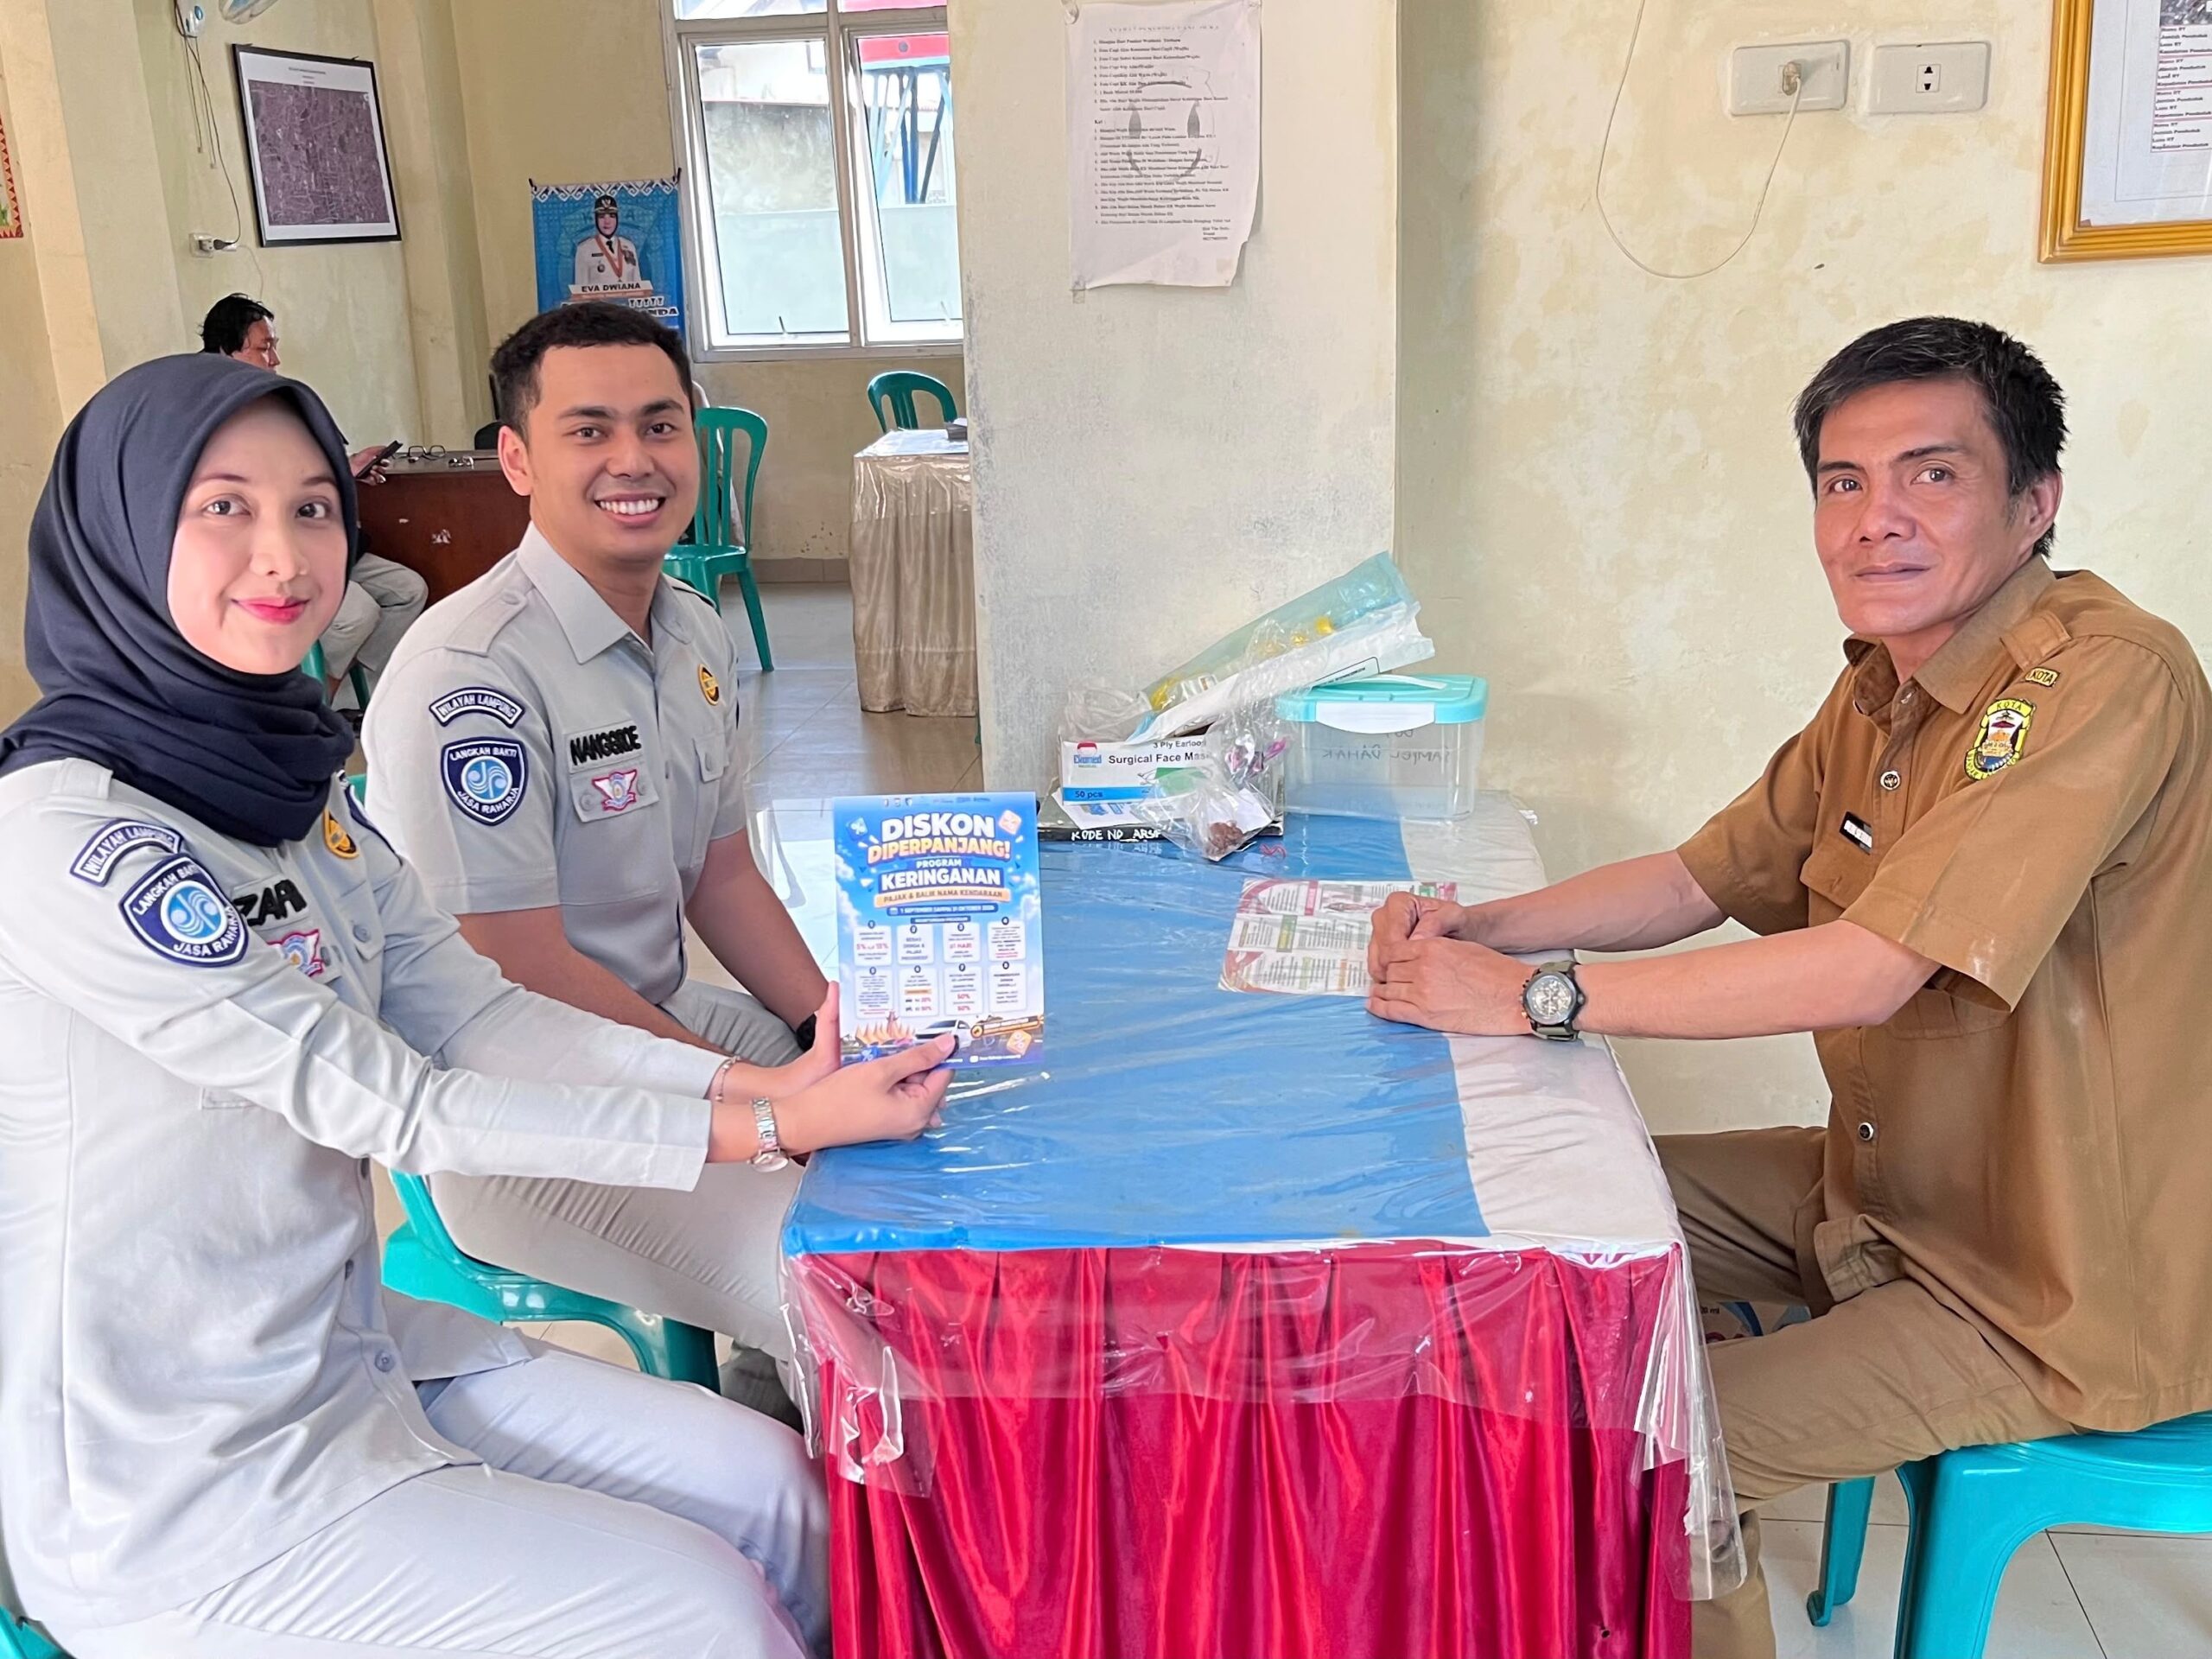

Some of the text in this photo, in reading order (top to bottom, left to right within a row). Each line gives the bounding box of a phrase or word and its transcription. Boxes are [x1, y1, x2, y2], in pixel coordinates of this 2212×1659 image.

[602, 283, 641, 292] DWIANA
[436, 694, 517, 718] WILAYAH LAMPUNG
[1997, 702, 2022, 711] KOTA
[450, 747, 517, 760] LANGKAH BAKTI
[1160, 741, 1173, 749] Ply
[1109, 754, 1153, 766] Surgical
[1156, 753, 1181, 762] Face
[457, 787, 519, 813] JASA RAHARJA
[881, 812, 995, 843] DISKON
[1071, 829, 1103, 841] KODE
[82, 830, 128, 874] WILAYAH
[868, 836, 1011, 864] DIPERPANJANG!
[916, 858, 963, 869] PROGRAM
[881, 868, 1001, 892] KERINGANAN
[132, 873, 179, 915] LANGKAH
[883, 892, 906, 903] PAJAK
[916, 890, 936, 899] BALIK
[960, 889, 1003, 898] KENDARAAN
[173, 906, 239, 957] JASA RAHARJA
